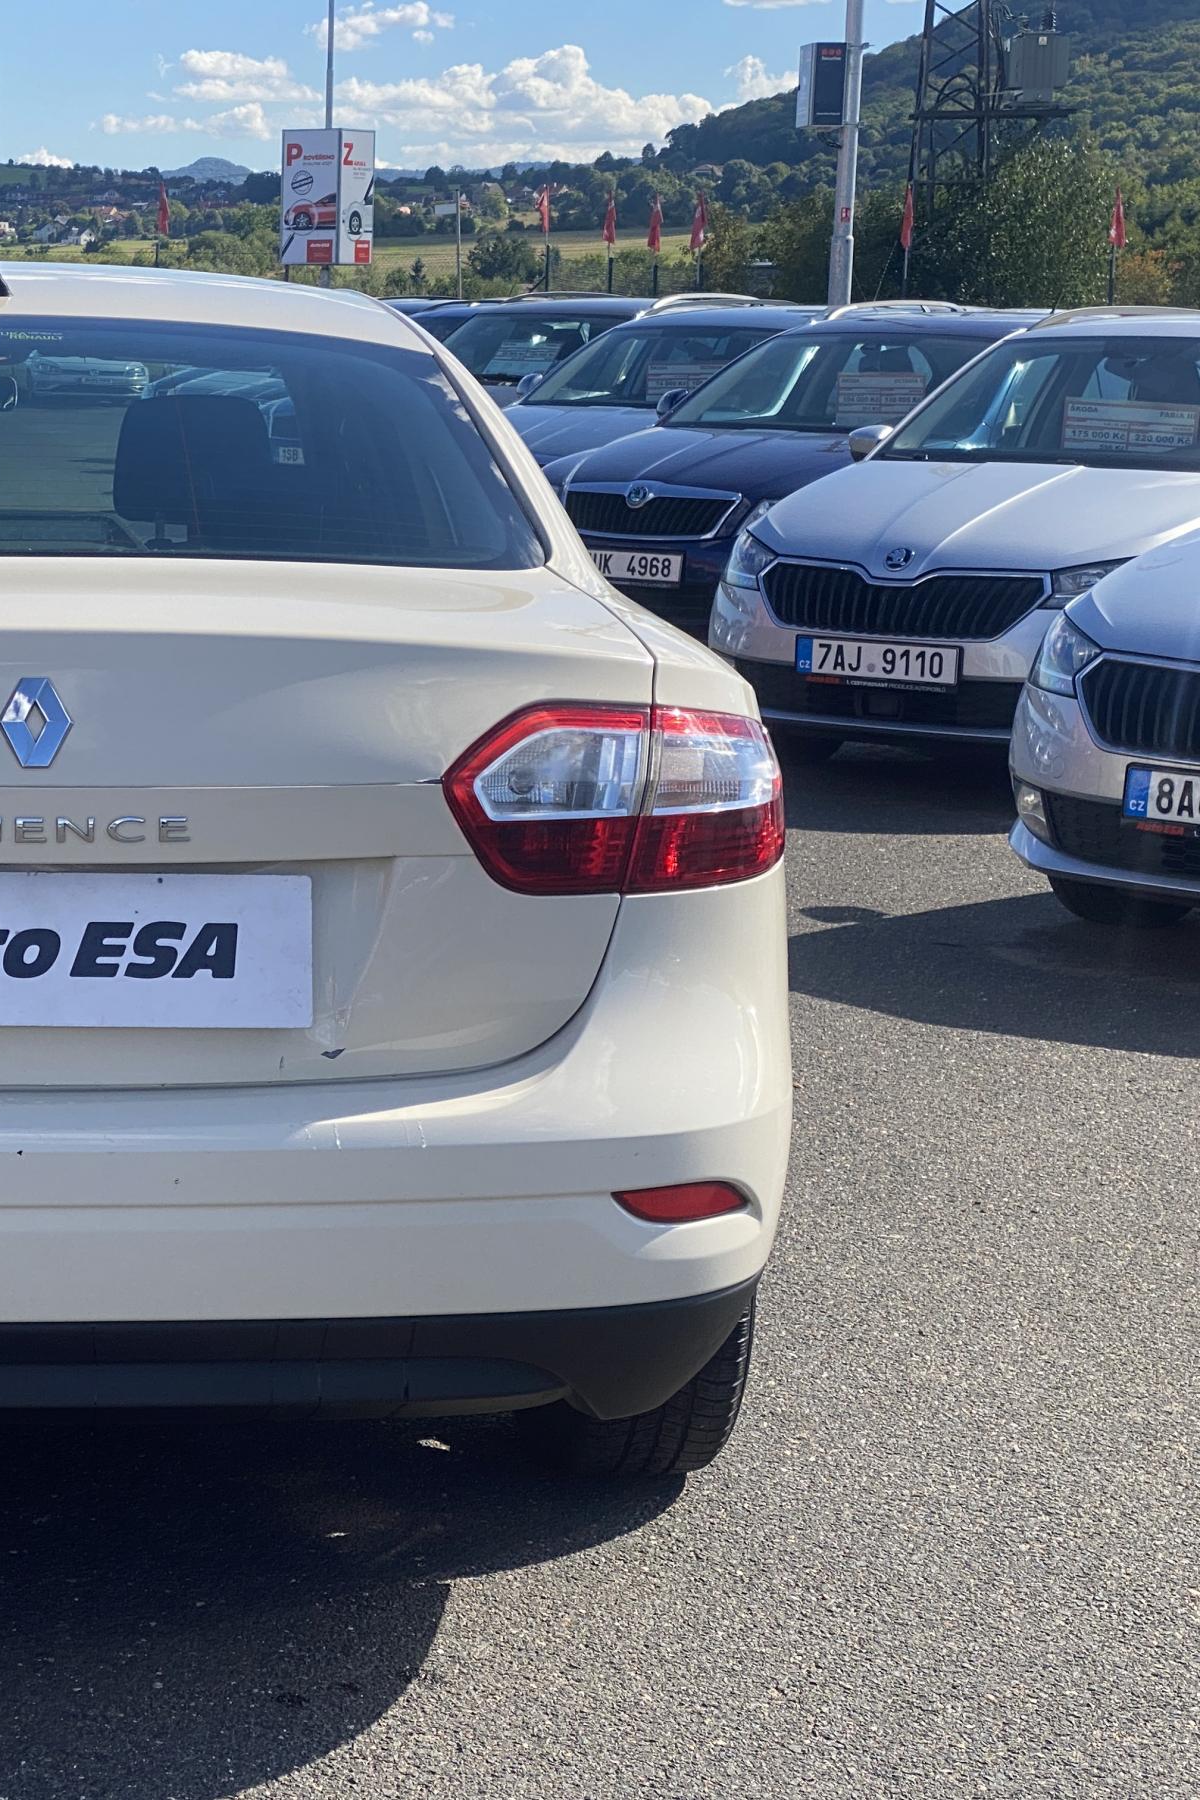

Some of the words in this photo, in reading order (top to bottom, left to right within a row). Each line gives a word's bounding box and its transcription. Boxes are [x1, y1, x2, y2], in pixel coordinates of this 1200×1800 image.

[1071, 430, 1089, 438] 175
[1092, 431, 1110, 439] 000
[1112, 432, 1126, 440] Kč
[1155, 435, 1174, 444] 000
[1177, 436, 1191, 445] Kč
[626, 554, 672, 578] 4968
[800, 660, 810, 669] CZ
[818, 643, 862, 672] 7AJ
[882, 648, 944, 678] 9110
[1130, 800, 1145, 812] CZ
[1156, 778, 1200, 818] 8A
[69, 921, 240, 980] ESA
